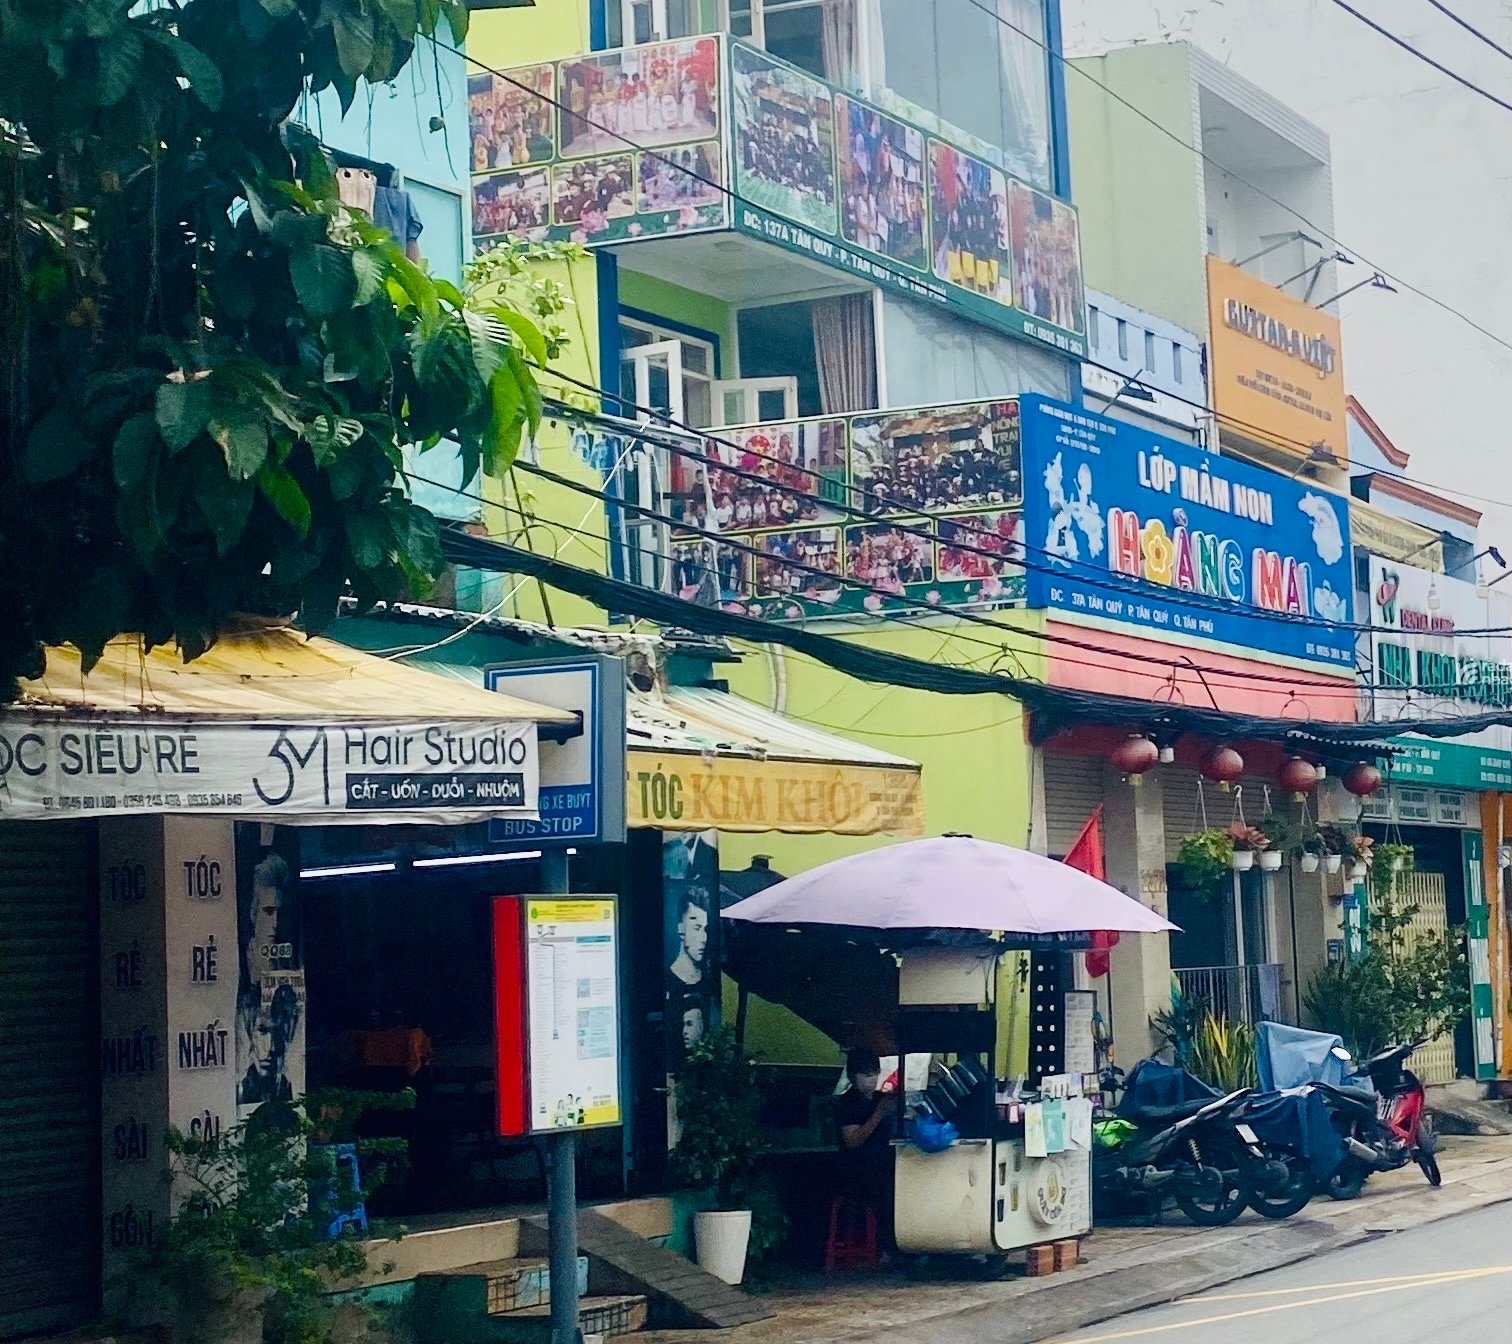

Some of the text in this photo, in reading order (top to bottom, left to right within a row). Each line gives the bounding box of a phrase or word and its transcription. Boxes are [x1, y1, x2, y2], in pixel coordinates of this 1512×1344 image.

[764, 219, 789, 241] 137A
[1137, 445, 1273, 526] LỚP MẦM NON
[1088, 594, 1103, 610] TÂN
[1252, 547, 1315, 617] MAI
[344, 726, 527, 765] Hair Studio
[351, 777, 380, 800] CẮT
[391, 776, 421, 800] UỐN
[552, 794, 564, 809] XE
[638, 763, 684, 820] TÓC
[690, 773, 766, 822] KIM
[504, 816, 583, 835] BUS STOP
[183, 854, 221, 897] TÓC
[192, 934, 218, 982] RẺ
[178, 1019, 228, 1069] NHẤT
